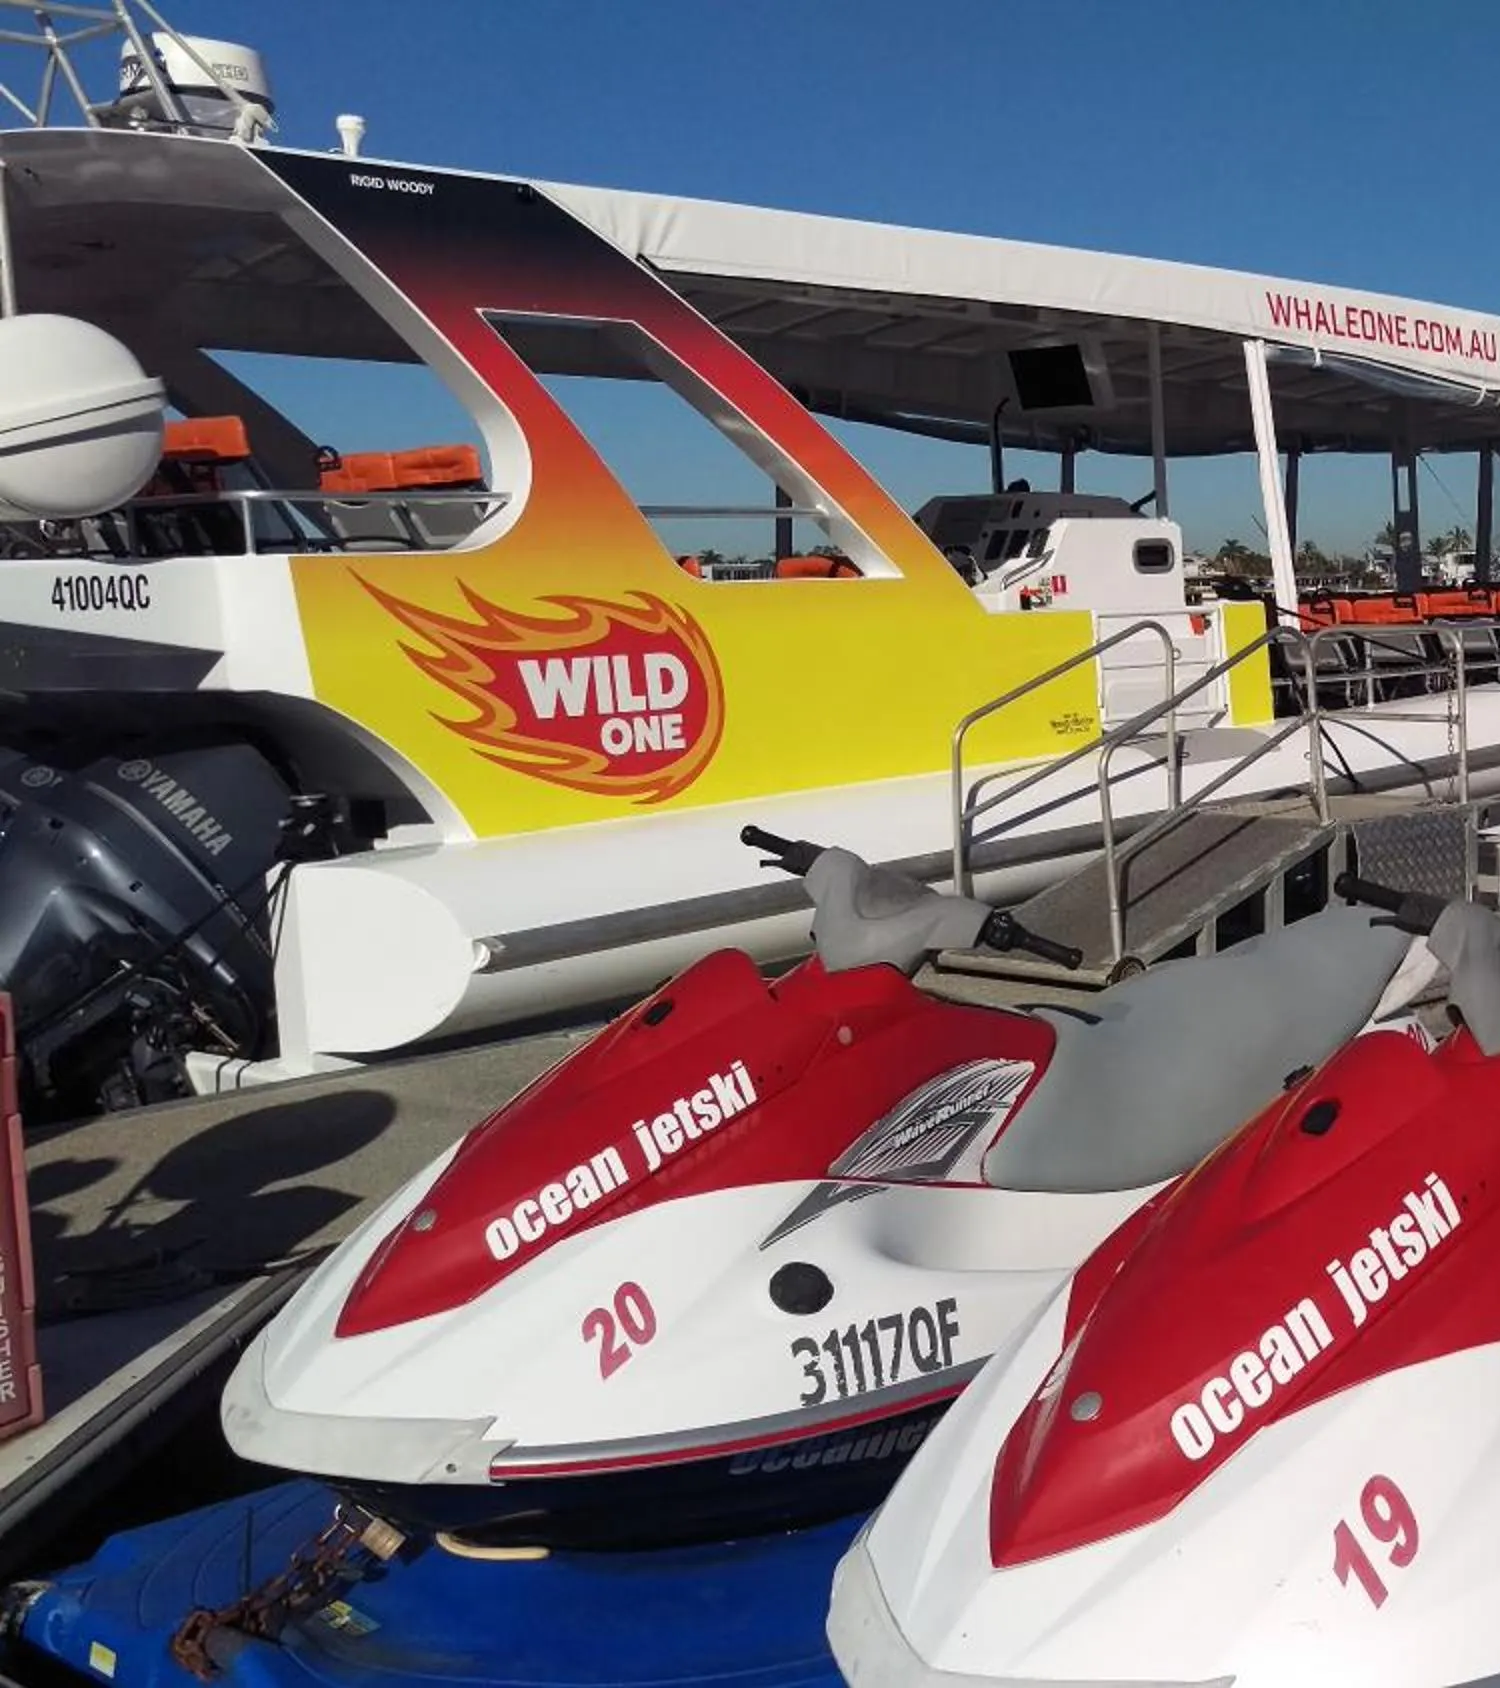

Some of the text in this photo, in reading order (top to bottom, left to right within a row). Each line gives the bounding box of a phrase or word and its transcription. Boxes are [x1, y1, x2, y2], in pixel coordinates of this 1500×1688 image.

[350, 173, 435, 195] RIGID WOODY
[1266, 291, 1497, 363] WHALEONE.COM.AU
[52, 573, 150, 611] 41004QC
[518, 652, 689, 719] WILD
[600, 713, 687, 756] ONE
[139, 769, 233, 856] YAMAHA
[485, 1060, 758, 1261] ocean jetski
[581, 1281, 657, 1381] 20
[790, 1297, 960, 1408] 31117QF
[1170, 1297, 1335, 1461] ocean
[1325, 1172, 1462, 1328] jetski
[1333, 1473, 1420, 1610] 19
